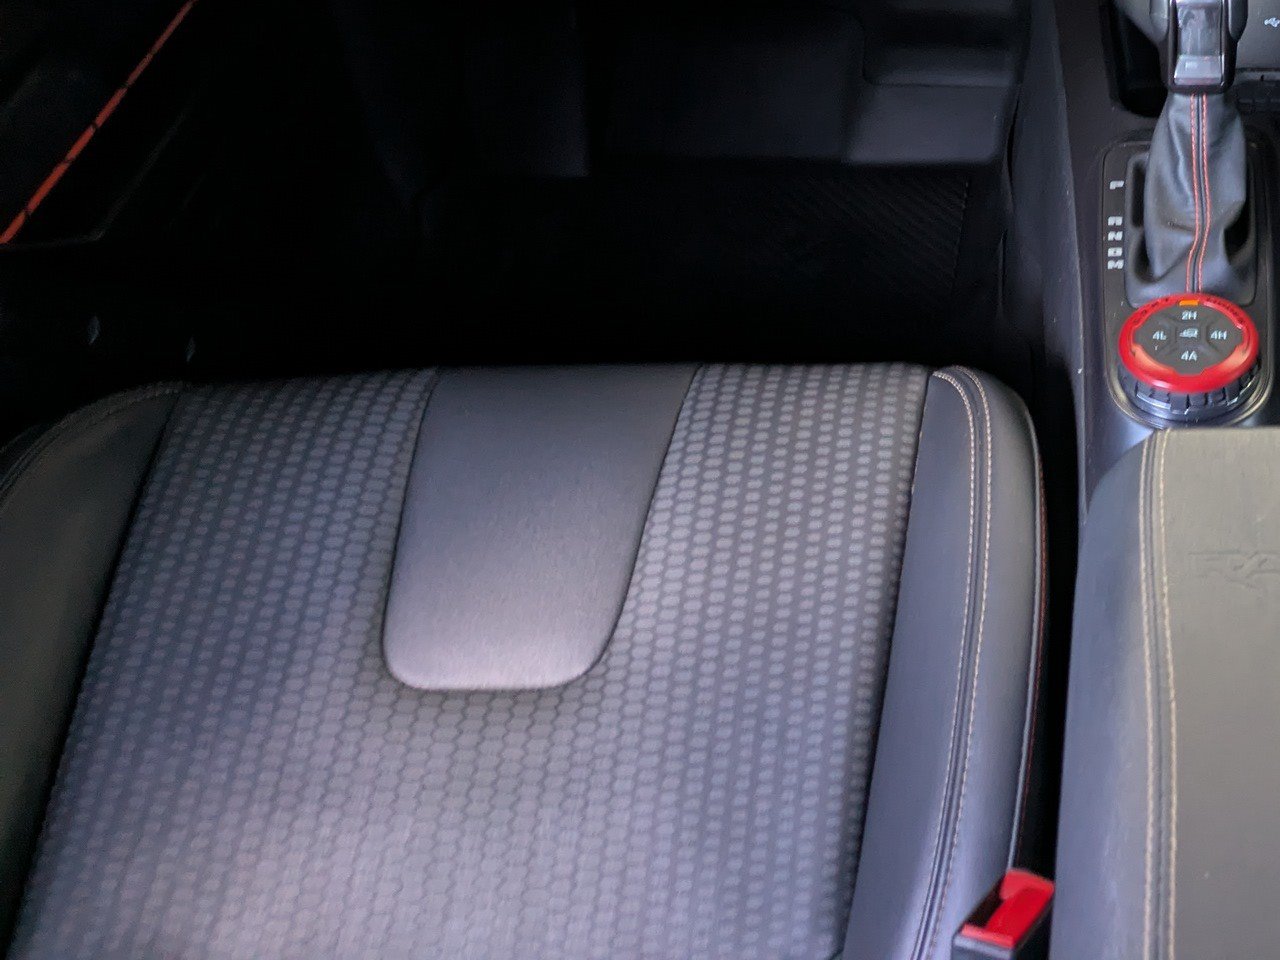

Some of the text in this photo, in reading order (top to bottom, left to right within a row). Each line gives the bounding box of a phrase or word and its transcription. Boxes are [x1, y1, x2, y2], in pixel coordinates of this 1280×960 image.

[1108, 180, 1125, 190] P
[1107, 230, 1123, 242] N
[1107, 246, 1123, 258] D
[1106, 260, 1124, 270] M
[1182, 310, 1198, 320] 2H
[1152, 330, 1167, 340] 4L
[1210, 330, 1228, 340] 4H
[1180, 350, 1198, 362] 4A
